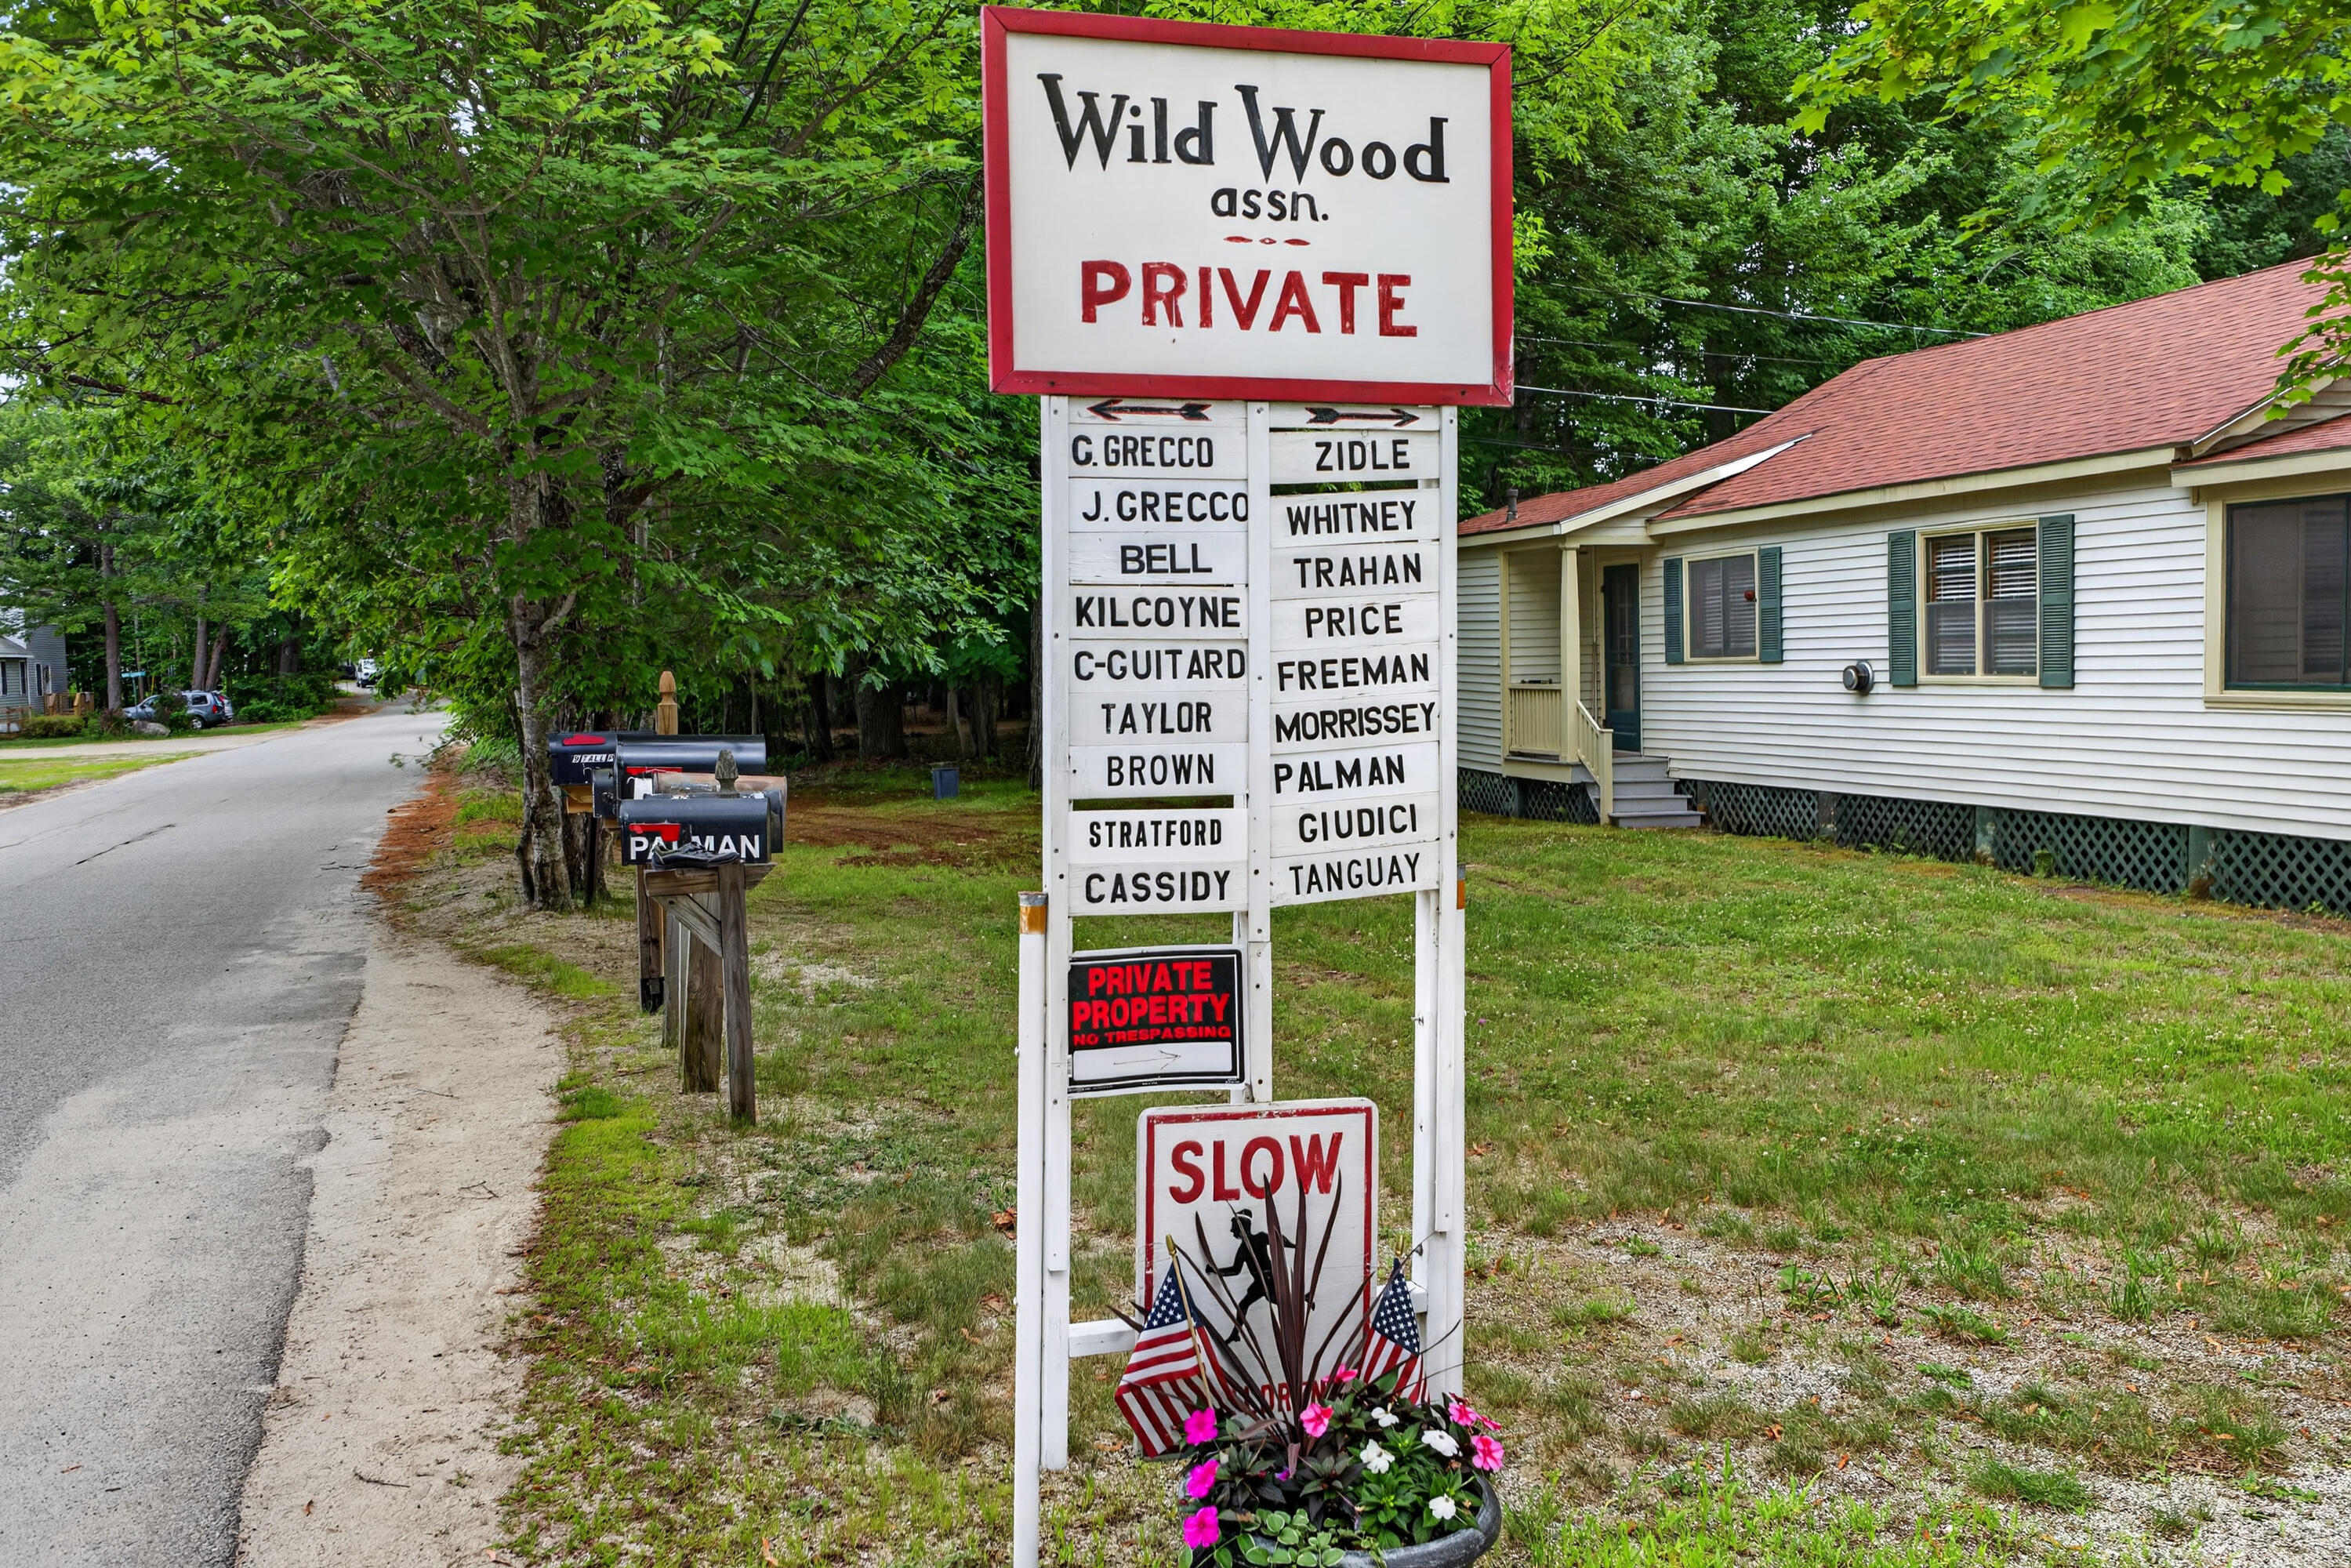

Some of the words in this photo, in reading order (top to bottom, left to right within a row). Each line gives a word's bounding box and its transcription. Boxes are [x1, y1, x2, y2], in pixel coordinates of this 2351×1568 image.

[1037, 74, 1217, 171] Wild
[1235, 85, 1450, 184] Wood
[1211, 187, 1329, 221] assn.
[1081, 260, 1417, 337] PRIVATE
[1104, 435, 1214, 467] GRECCO
[1315, 439, 1410, 471] ZIDLE
[1116, 491, 1248, 522] GRECCO
[1286, 500, 1416, 536] WHITNEY
[1120, 543, 1213, 575] BELL
[1293, 553, 1421, 588] TRAHAN
[1076, 597, 1240, 628] KILCOYNE
[1306, 604, 1403, 638] PRICE
[1074, 649, 1245, 681] C-GUITARD
[1277, 653, 1429, 691] FREEMAN
[1101, 702, 1212, 735] TAYLOR
[1275, 702, 1435, 743] MORRISSEY
[1108, 753, 1214, 786] BROWN
[1275, 754, 1405, 794] PALMAN
[1089, 818, 1222, 848] STRATFORD
[1299, 804, 1417, 843] GIUDICI
[1085, 870, 1231, 903] CASSIDY
[1290, 852, 1420, 896] TANGUAY
[1088, 961, 1213, 996] PRIVATE
[1072, 993, 1231, 1031] PROPERTY
[1073, 1033, 1098, 1046] NO
[1105, 1025, 1232, 1044] TRESPASSING
[1169, 1131, 1343, 1204] SLOW
